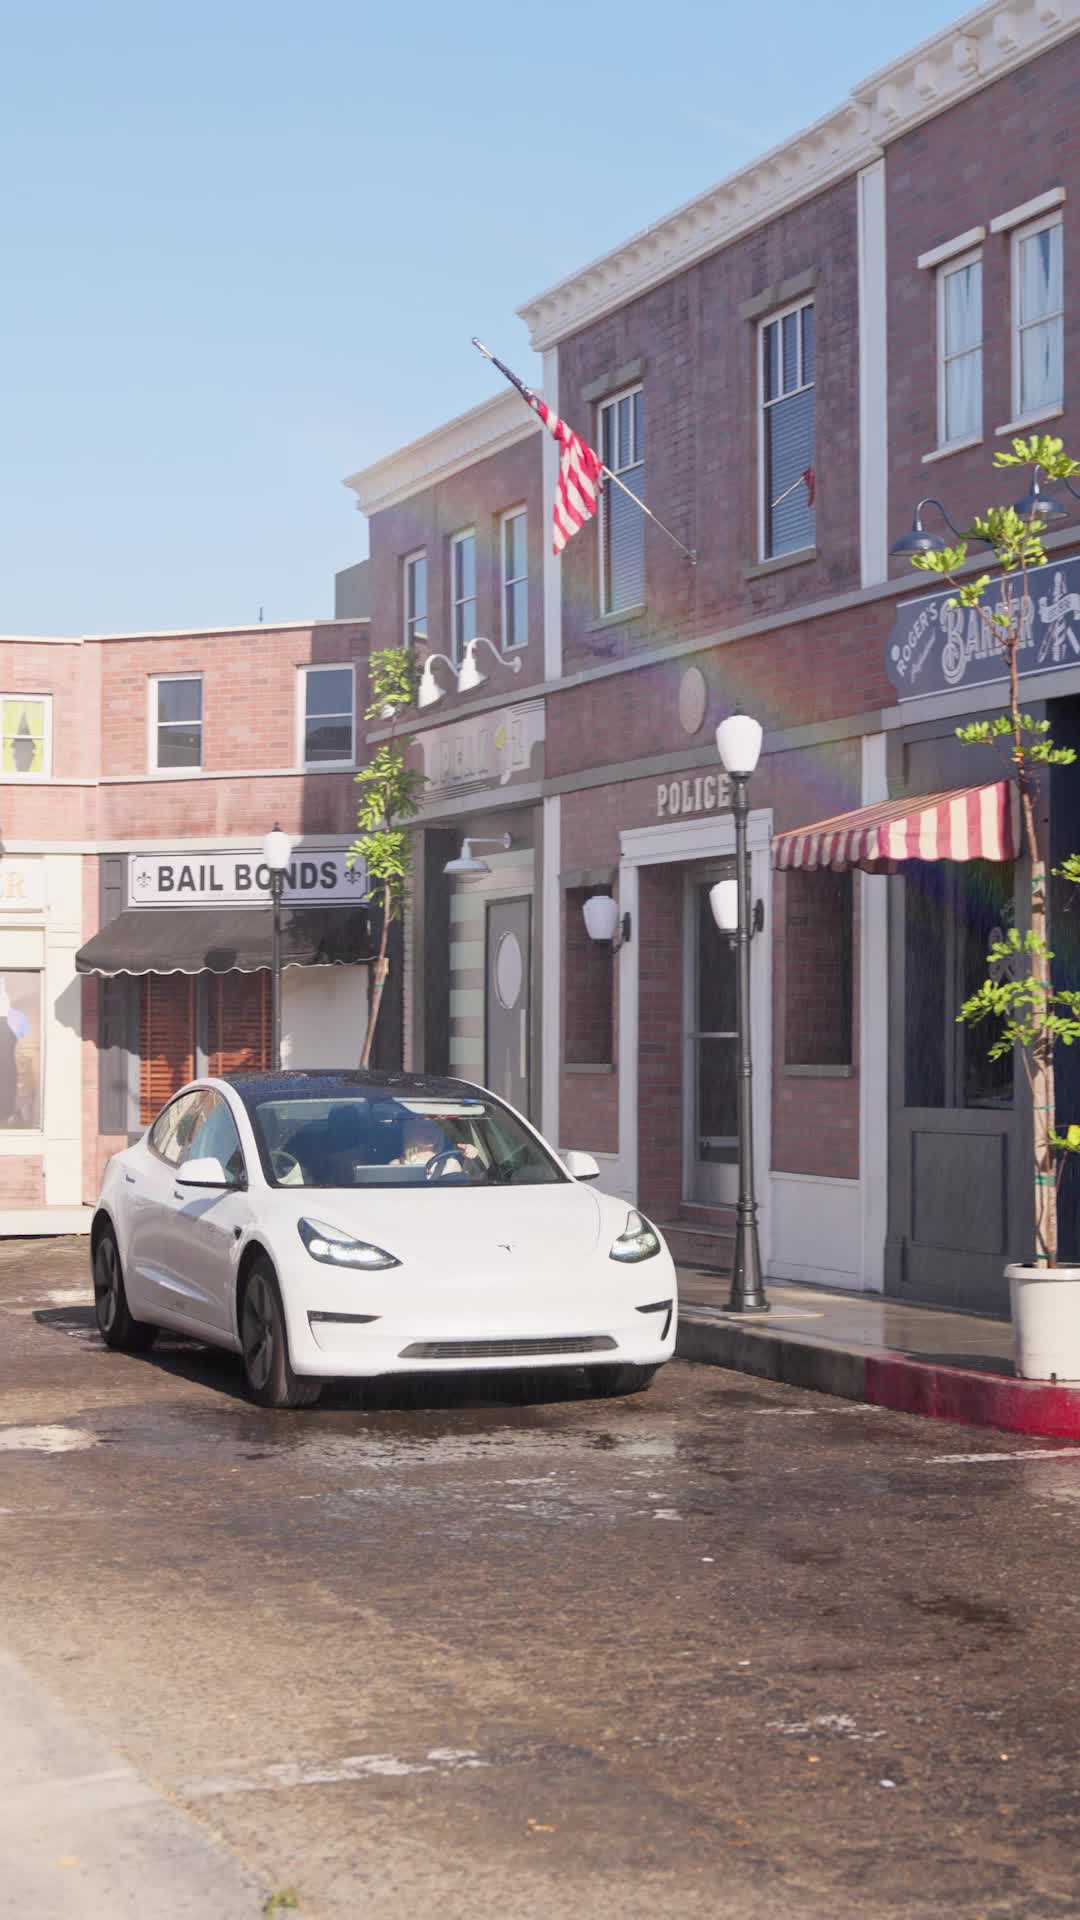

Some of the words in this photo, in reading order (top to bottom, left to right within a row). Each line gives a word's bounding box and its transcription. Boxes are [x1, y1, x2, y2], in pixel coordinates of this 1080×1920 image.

[896, 602, 937, 677] ROGER'S
[657, 773, 731, 817] POLICE
[157, 864, 224, 892] BAIL
[234, 862, 338, 890] BONDS
